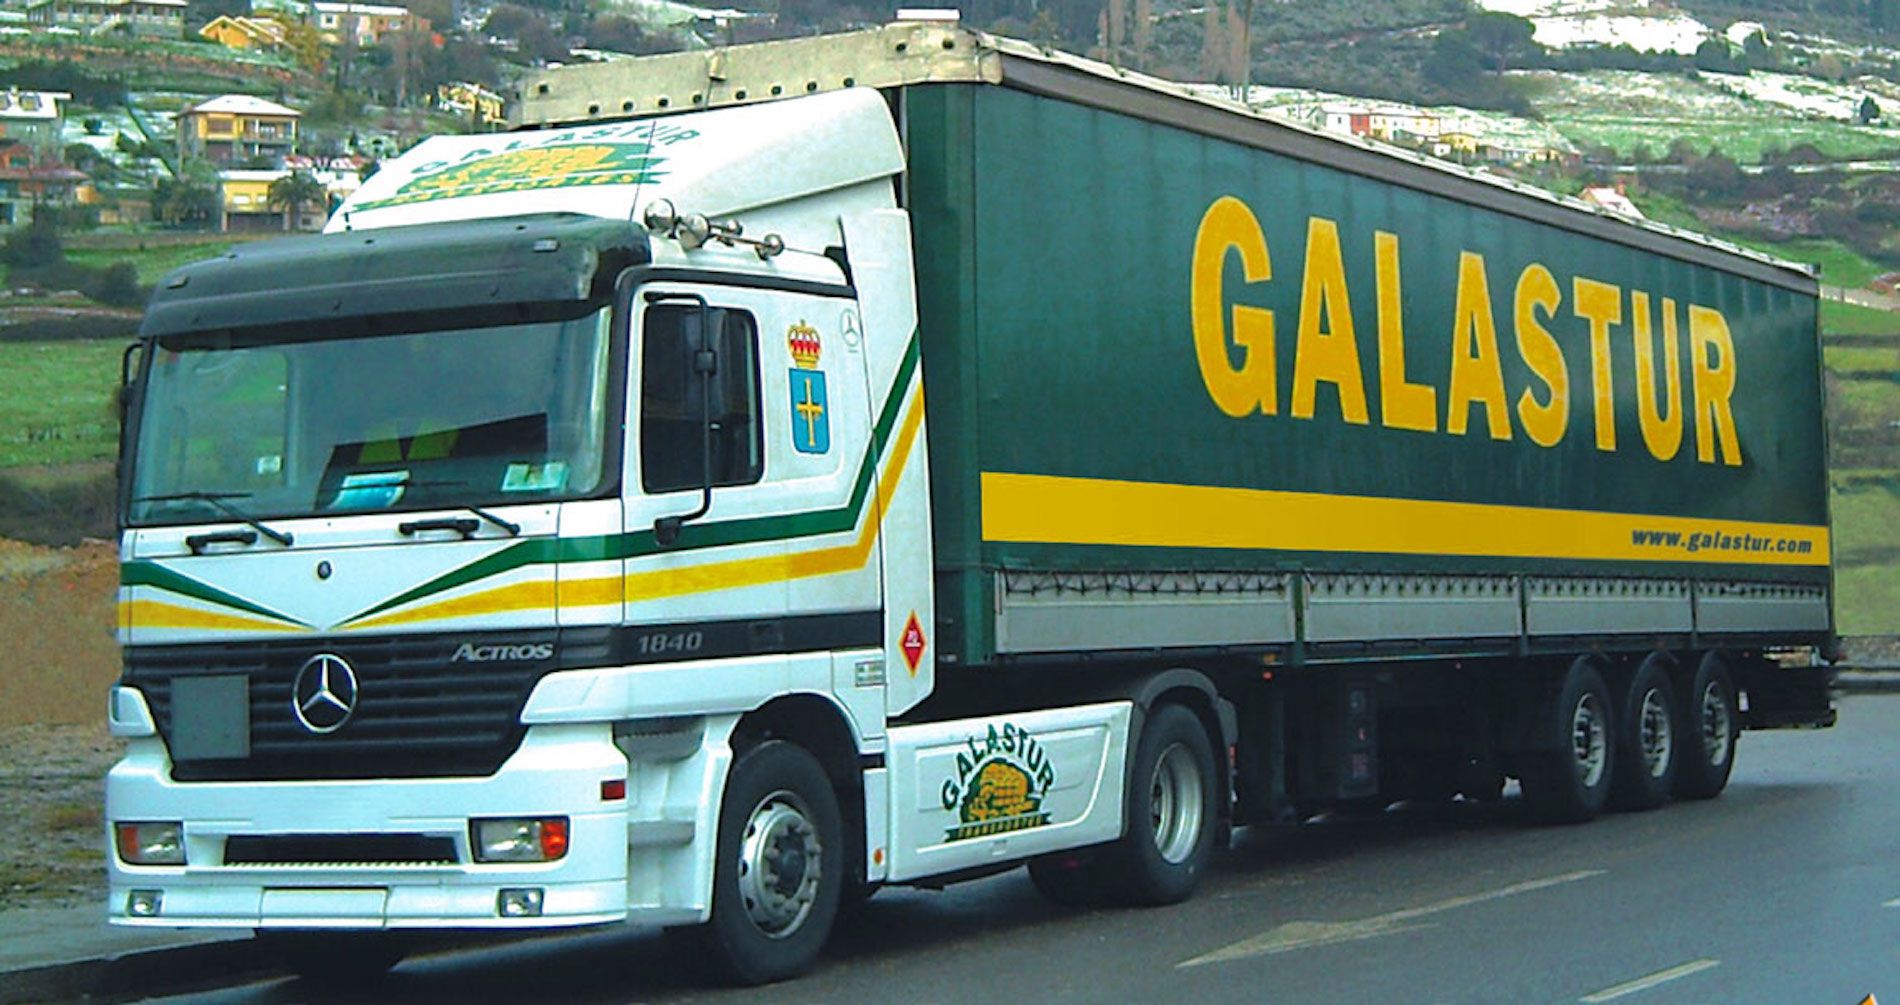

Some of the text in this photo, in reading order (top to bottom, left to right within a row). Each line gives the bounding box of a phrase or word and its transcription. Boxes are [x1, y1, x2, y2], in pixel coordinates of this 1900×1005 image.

[411, 124, 701, 174] GALASTUR
[1191, 195, 1743, 466] GALASTUR
[1631, 529, 1813, 553] www.galastur.com
[637, 631, 703, 655] 1840
[942, 722, 1054, 811] GALASTUR
